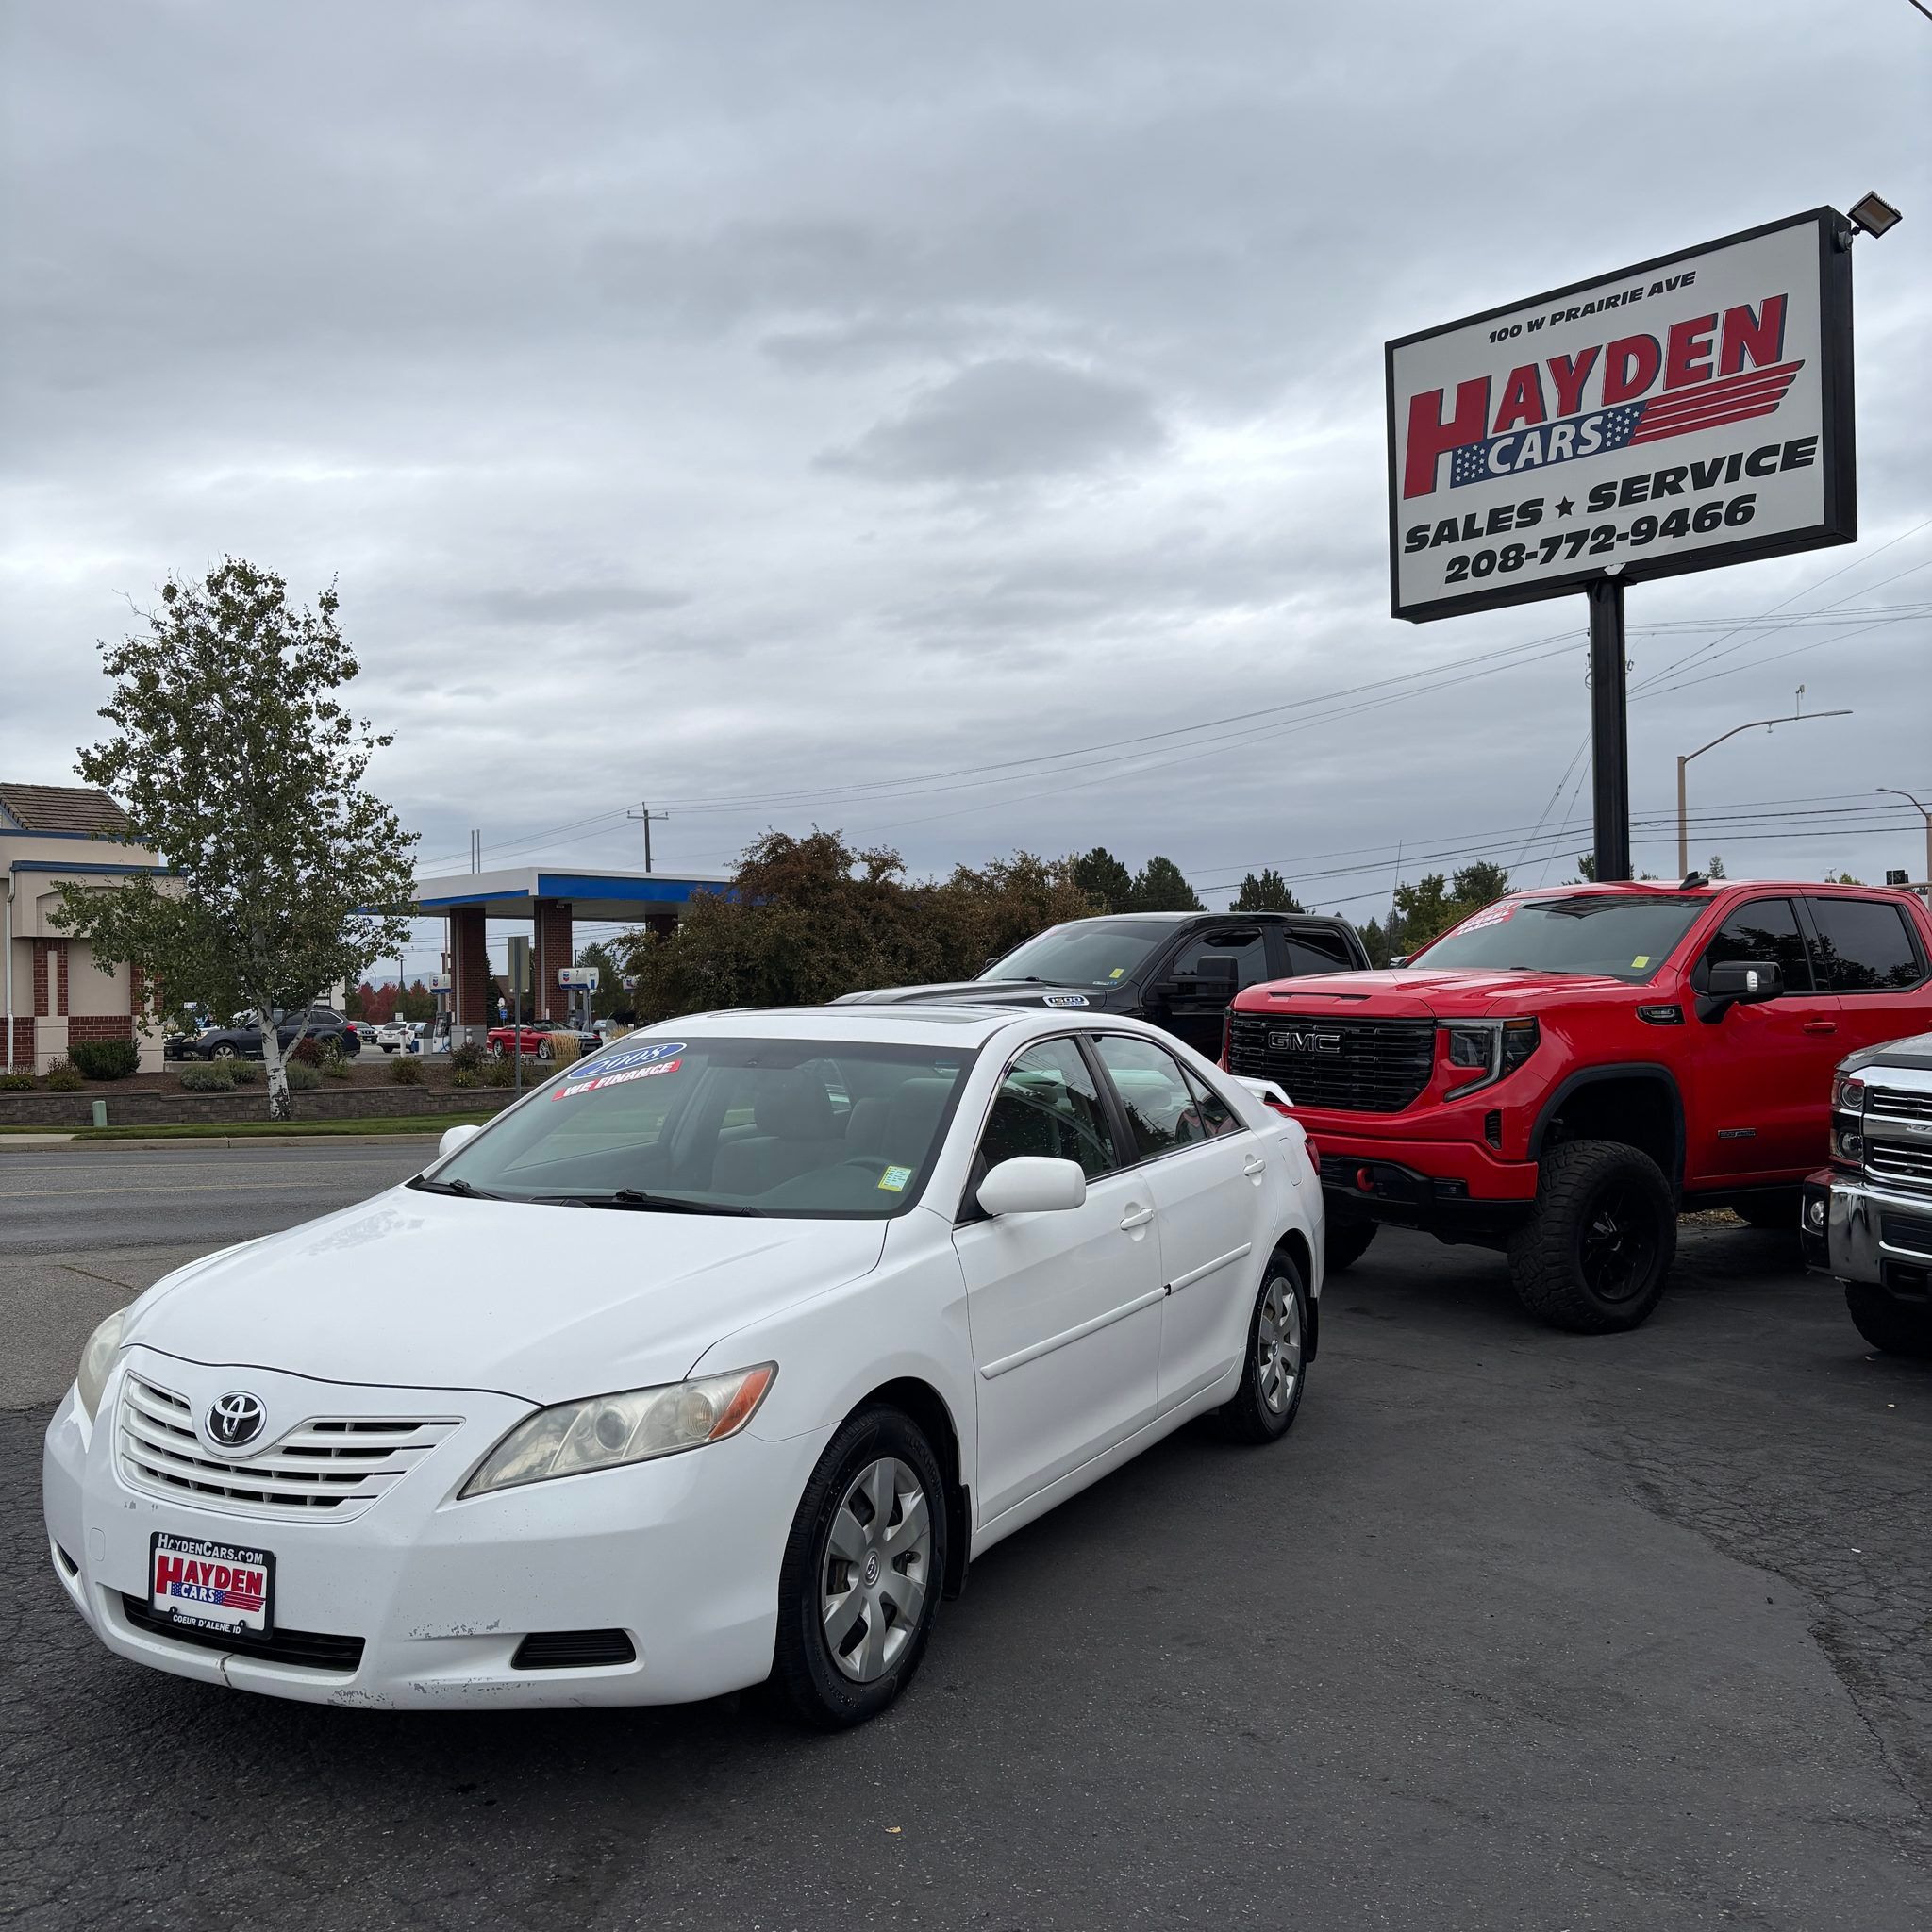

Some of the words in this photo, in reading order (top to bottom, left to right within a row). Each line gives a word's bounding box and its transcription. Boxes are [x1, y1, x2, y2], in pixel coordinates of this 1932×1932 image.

[1489, 324, 1523, 343] 100
[1527, 316, 1546, 333] W
[1549, 287, 1644, 326] PRAIRIE
[1648, 271, 1696, 297] AVE
[1404, 293, 1789, 500] HAYDEN
[1486, 415, 1604, 475] CARS
[1404, 498, 1545, 554] SALES
[1586, 435, 1820, 514] SERVICE
[1444, 493, 1757, 584] 208-772-9466
[585, 1045, 668, 1075] 2008
[1268, 1031, 1340, 1053] GMC
[563, 1080, 594, 1097] WE
[594, 1061, 675, 1089] FINANCE
[156, 1555, 264, 1595] HAYDEN
[181, 1583, 216, 1603] CARS
[173, 1614, 196, 1626] COEUR
[232, 1625, 242, 1634] ID
